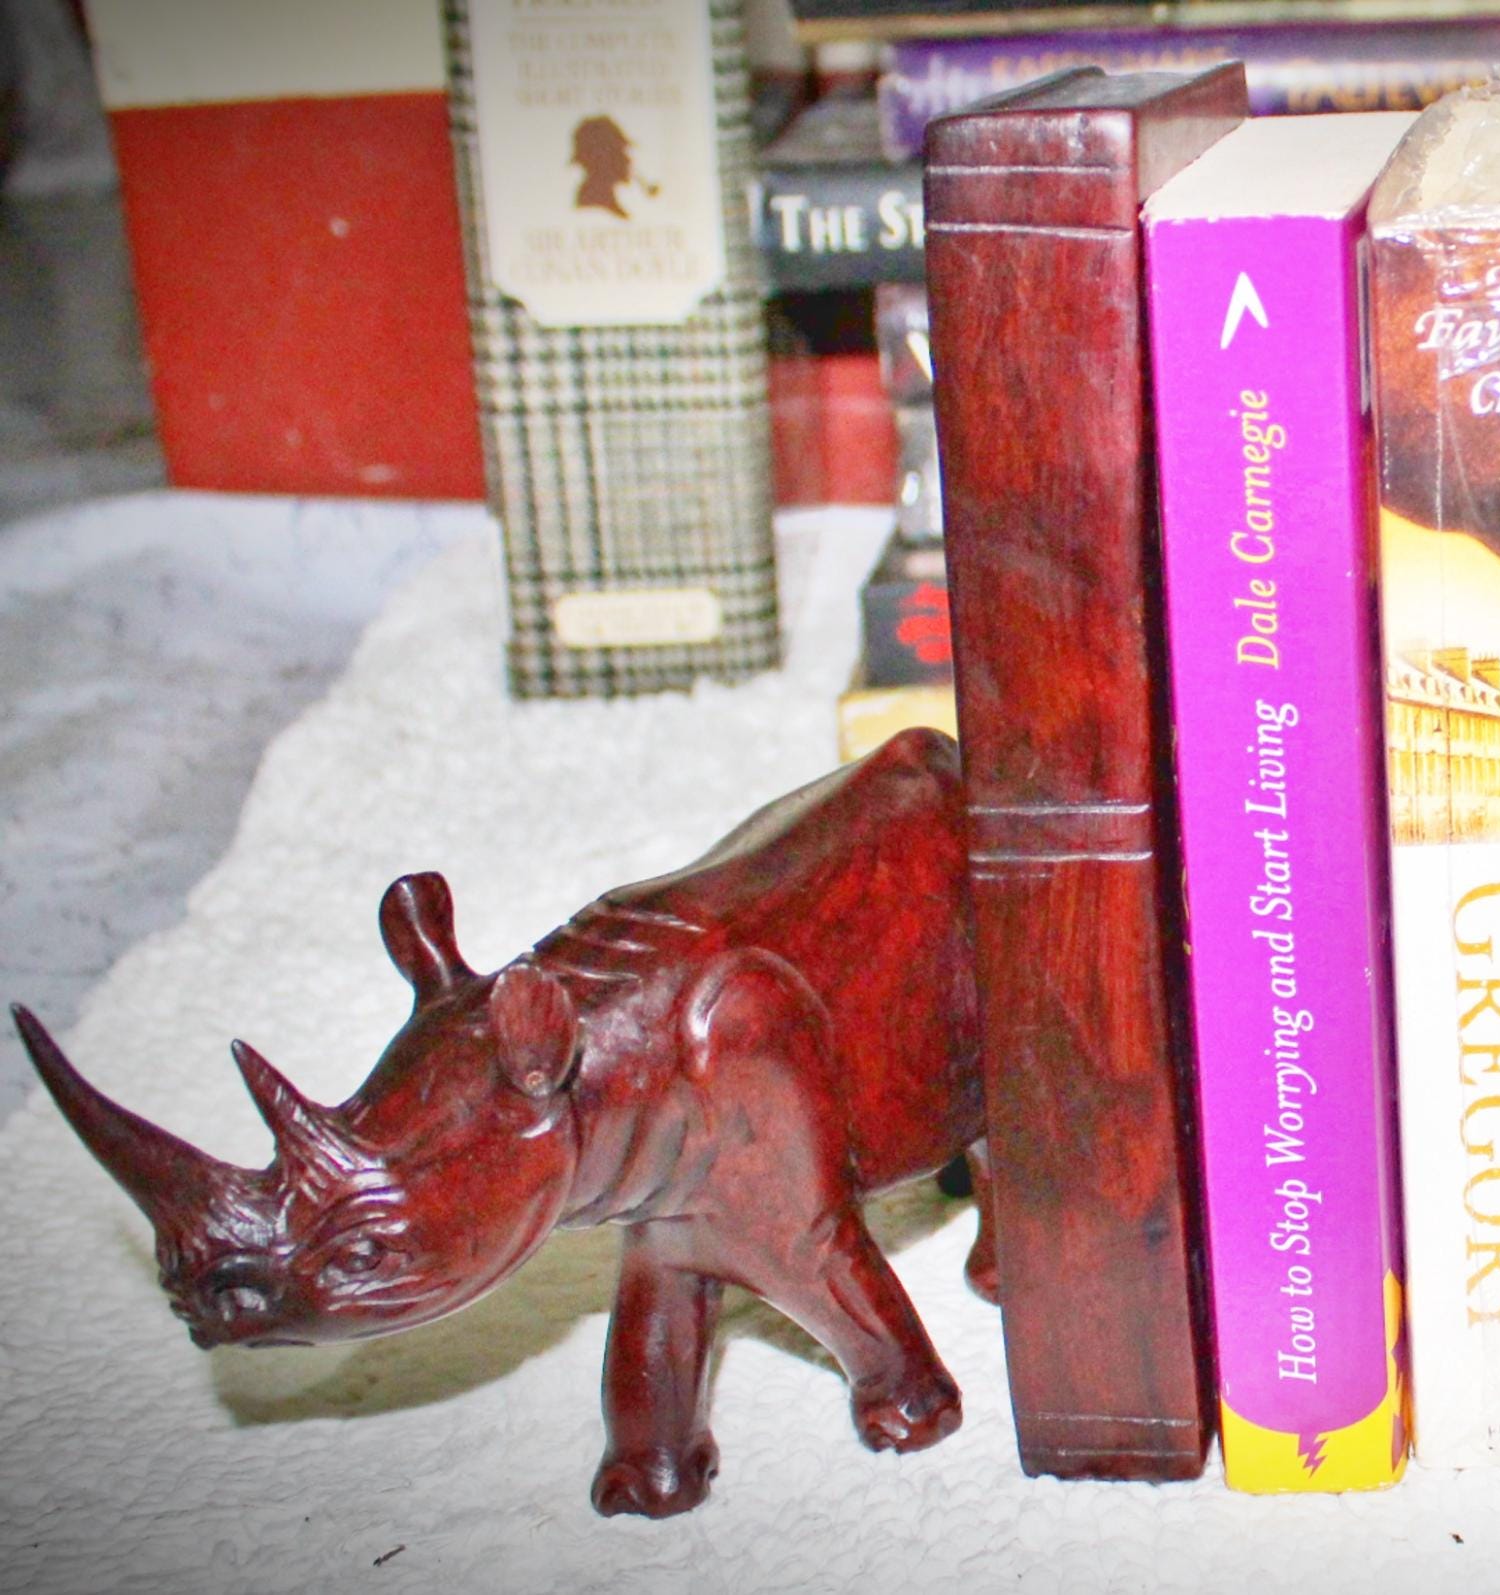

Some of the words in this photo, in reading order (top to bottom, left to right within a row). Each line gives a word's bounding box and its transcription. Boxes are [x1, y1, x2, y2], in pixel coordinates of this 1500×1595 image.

[769, 194, 863, 253] THE
[1228, 388, 1289, 565] Carnegie
[1231, 578, 1281, 671] Dale
[1244, 698, 1300, 820] Living
[1246, 827, 1294, 921] Start
[1251, 930, 1298, 999] and
[1264, 1005, 1317, 1168] Worrying
[1266, 1179, 1323, 1256] Stop
[1280, 1265, 1314, 1297] to
[1278, 1306, 1321, 1386] How
